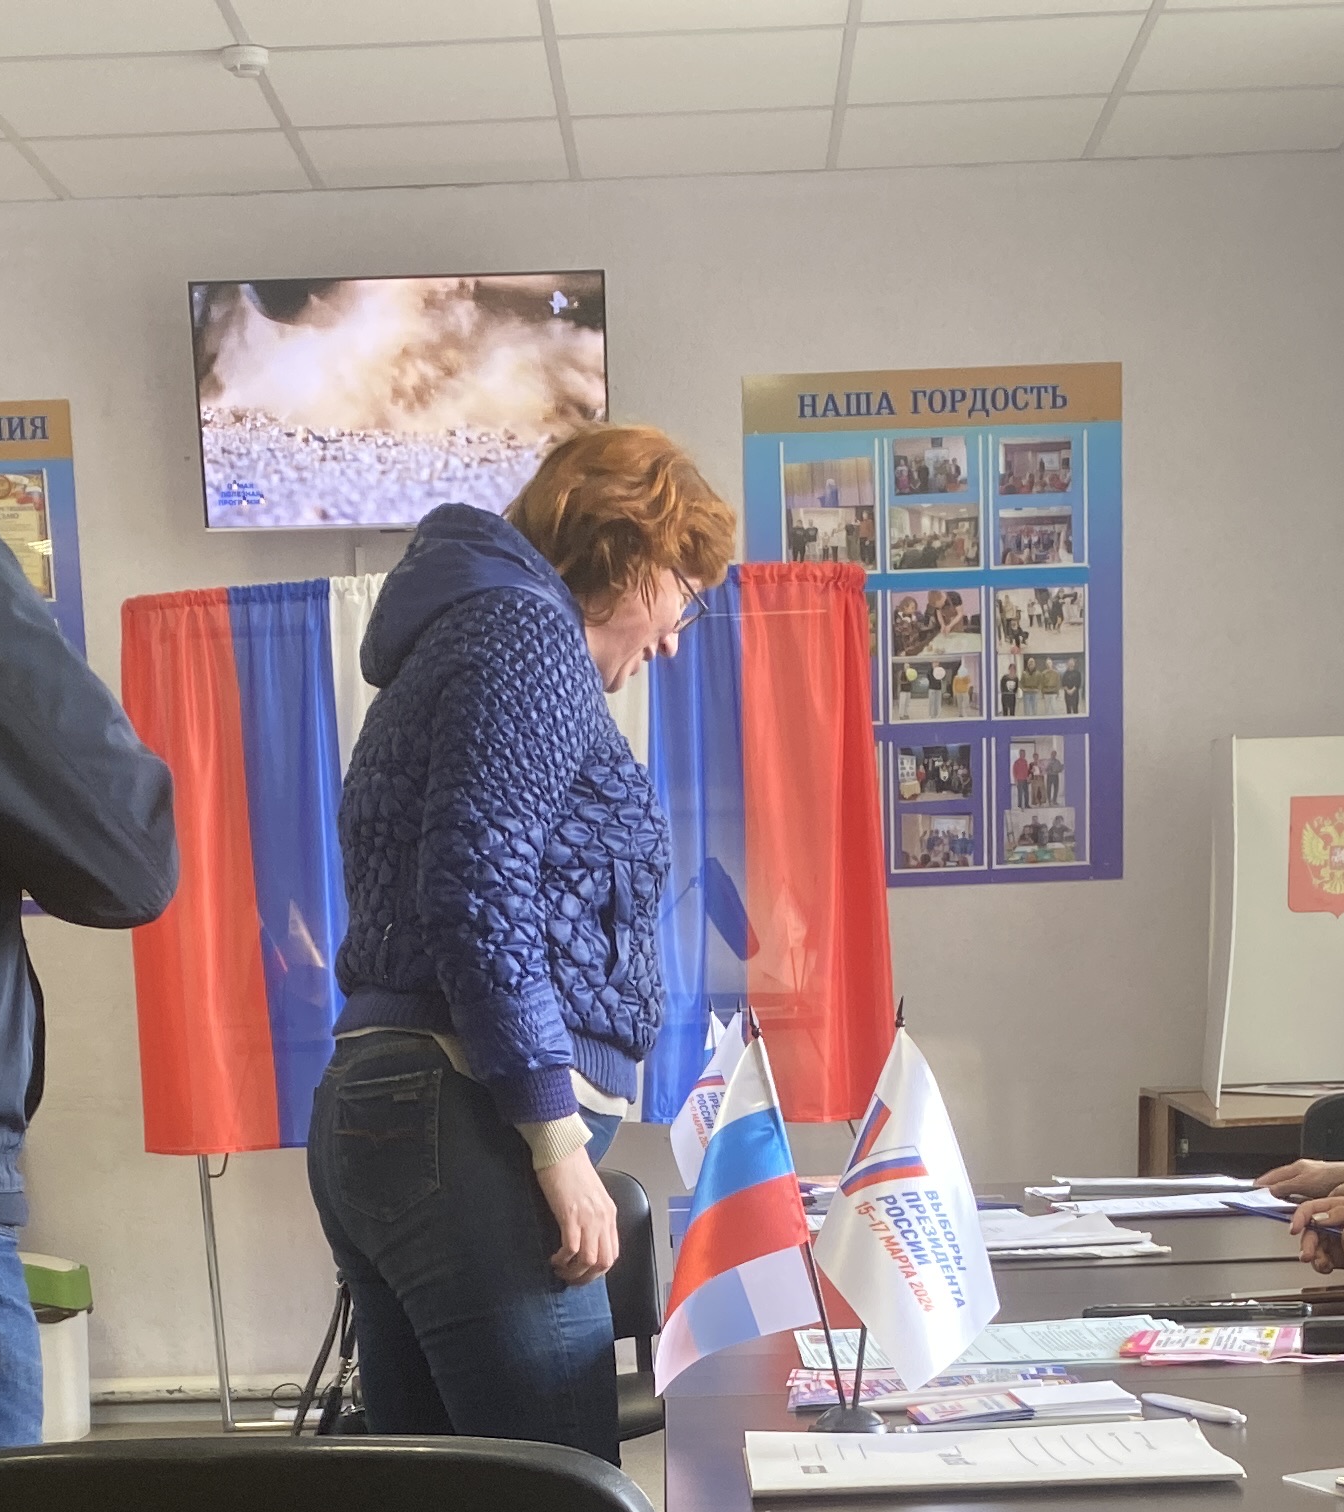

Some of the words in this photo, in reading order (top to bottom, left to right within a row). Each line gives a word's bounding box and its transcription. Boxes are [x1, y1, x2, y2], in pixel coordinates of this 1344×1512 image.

[797, 391, 896, 419] НАША
[910, 384, 1069, 419] ГОРДОСТЬ
[875, 1194, 932, 1266] РОССИИ
[901, 1191, 966, 1308] ПРЕЗИДЕНТА
[924, 1190, 967, 1271] ВЫБОРЫ
[879, 1235, 918, 1279] МАРТА
[908, 1281, 936, 1312] 2024
